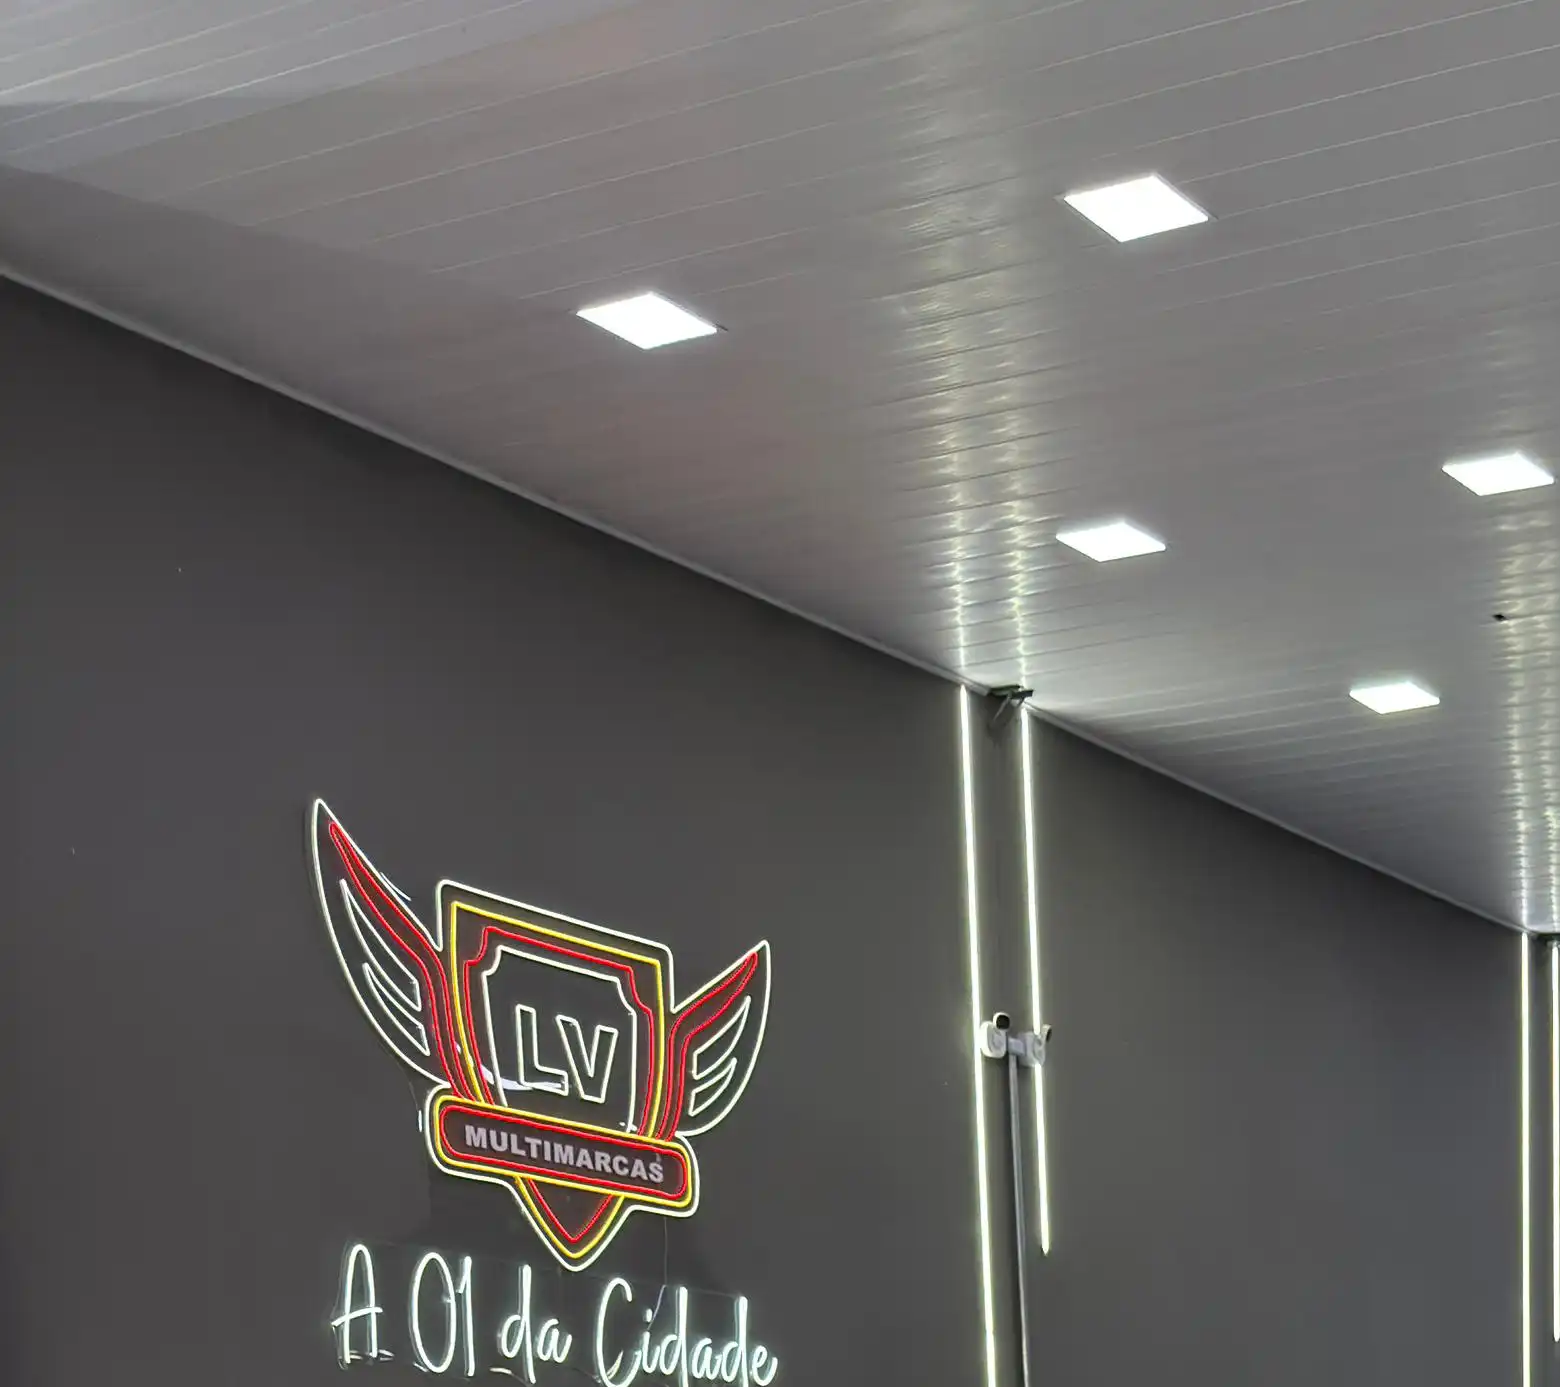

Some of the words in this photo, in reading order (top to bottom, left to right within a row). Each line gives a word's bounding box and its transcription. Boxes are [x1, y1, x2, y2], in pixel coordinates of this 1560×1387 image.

[515, 1004, 618, 1103] LV
[464, 1124, 665, 1184] MULTIMARCAS
[331, 1243, 383, 1365] A
[498, 1263, 573, 1385] da
